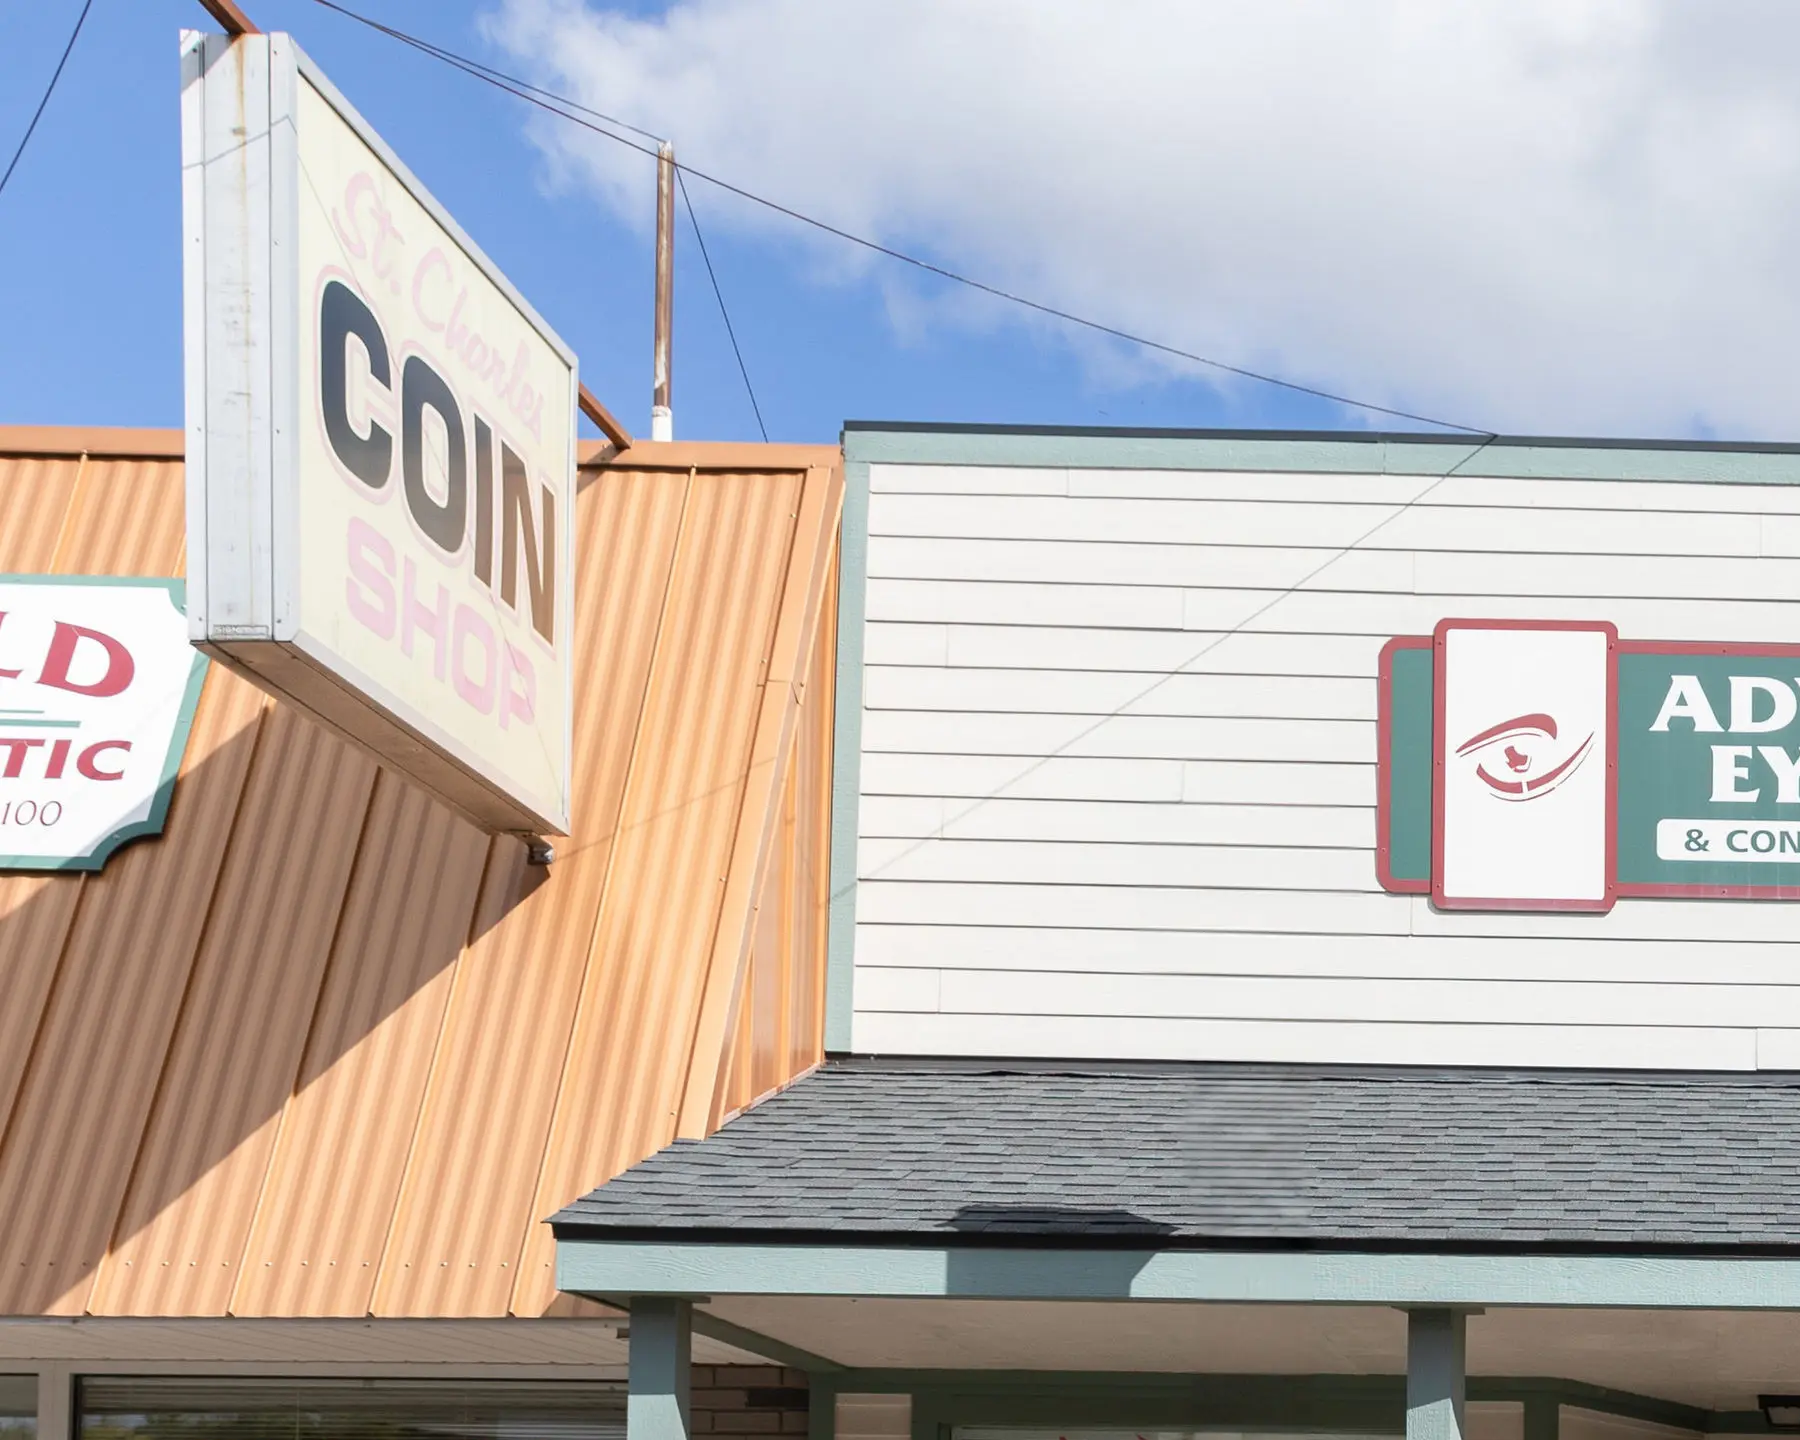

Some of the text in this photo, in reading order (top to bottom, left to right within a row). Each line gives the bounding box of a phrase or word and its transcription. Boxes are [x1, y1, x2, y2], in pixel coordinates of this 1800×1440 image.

[332, 171, 544, 446] St. Charles
[320, 280, 556, 647] COIN
[346, 516, 537, 731] SHOP
[1684, 829, 1710, 855] &
